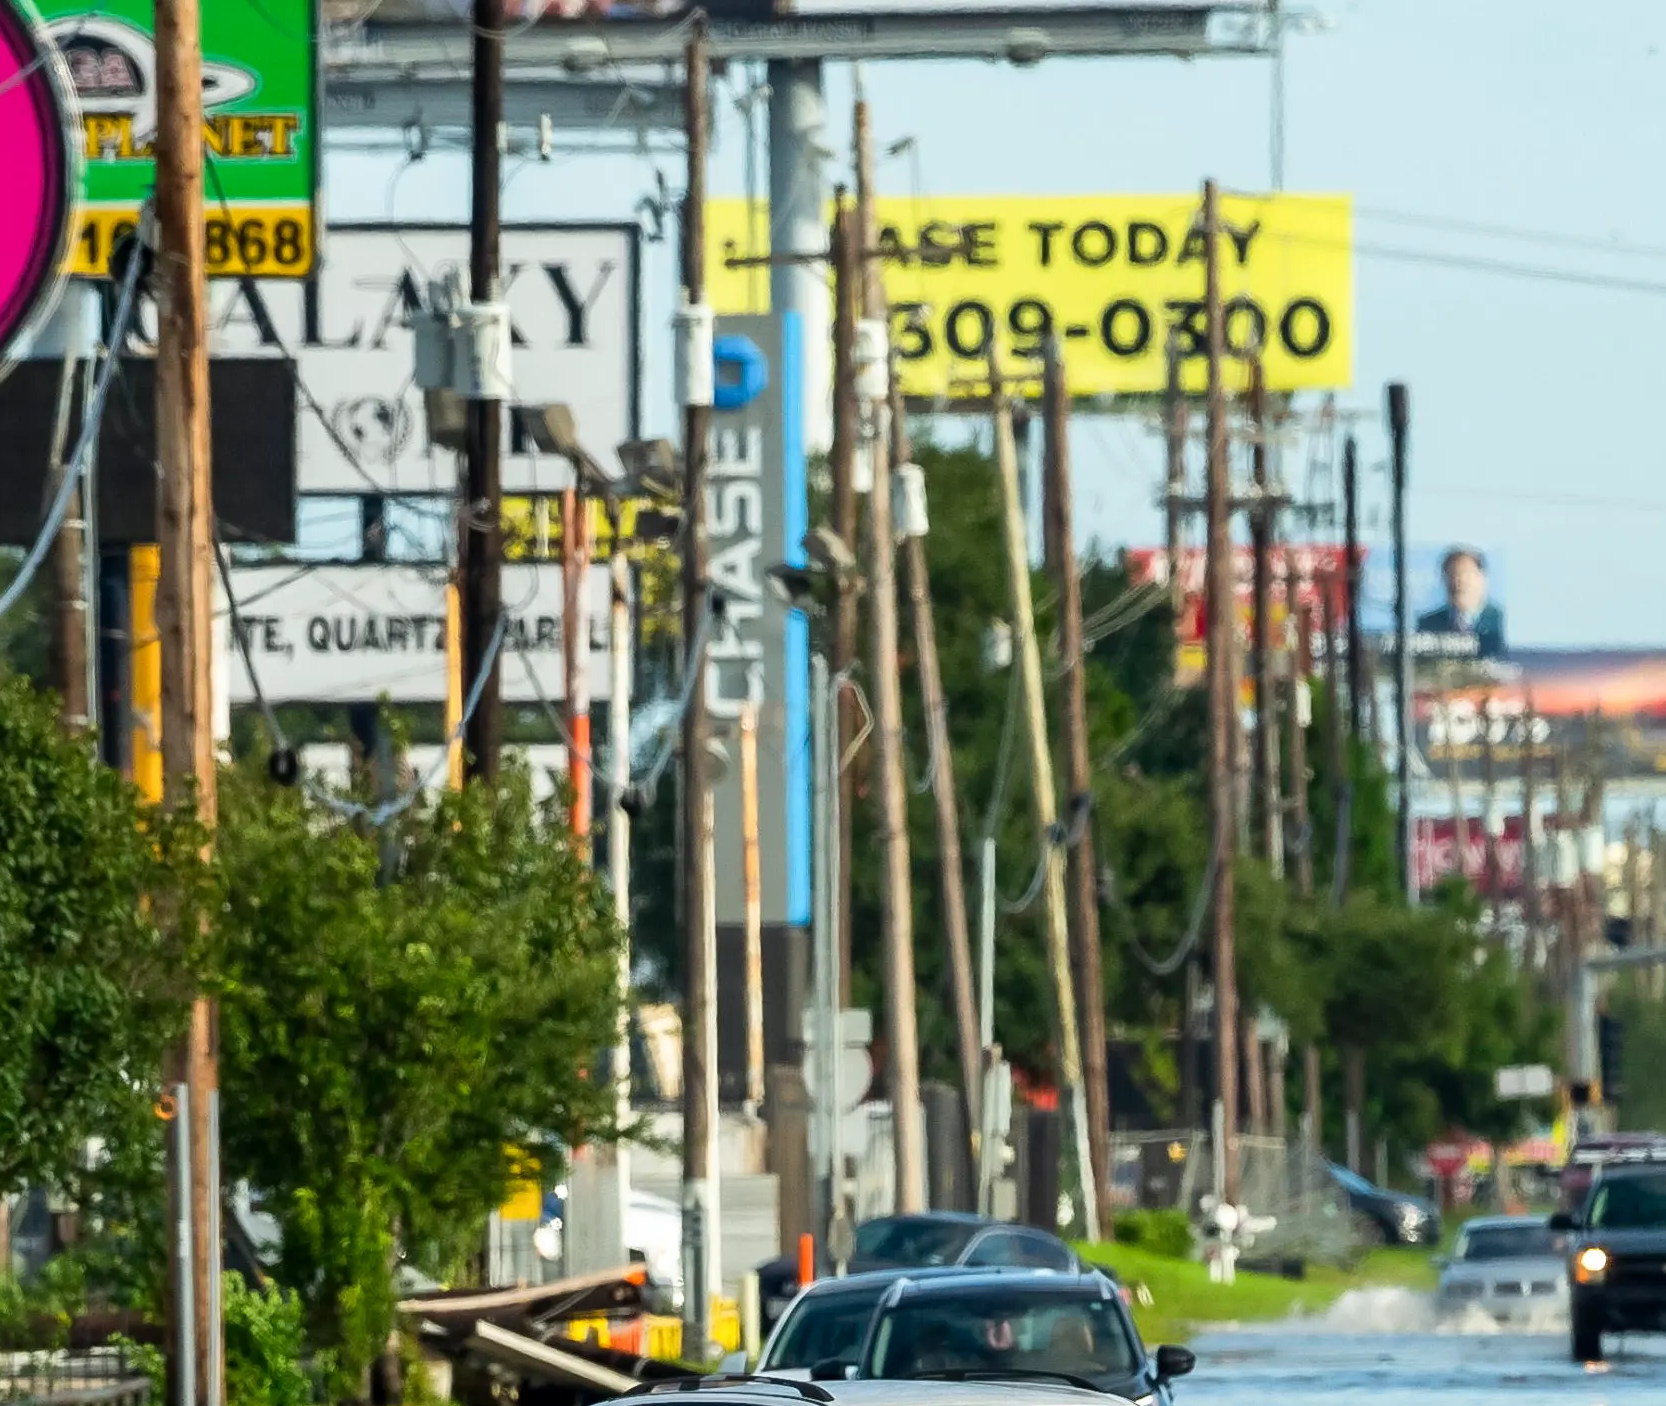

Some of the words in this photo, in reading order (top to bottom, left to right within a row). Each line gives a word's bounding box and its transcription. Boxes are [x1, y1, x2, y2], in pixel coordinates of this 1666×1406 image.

[83, 114, 298, 158] PLNET
[1028, 220, 1261, 267] TODAY
[704, 424, 765, 720] CHASE
